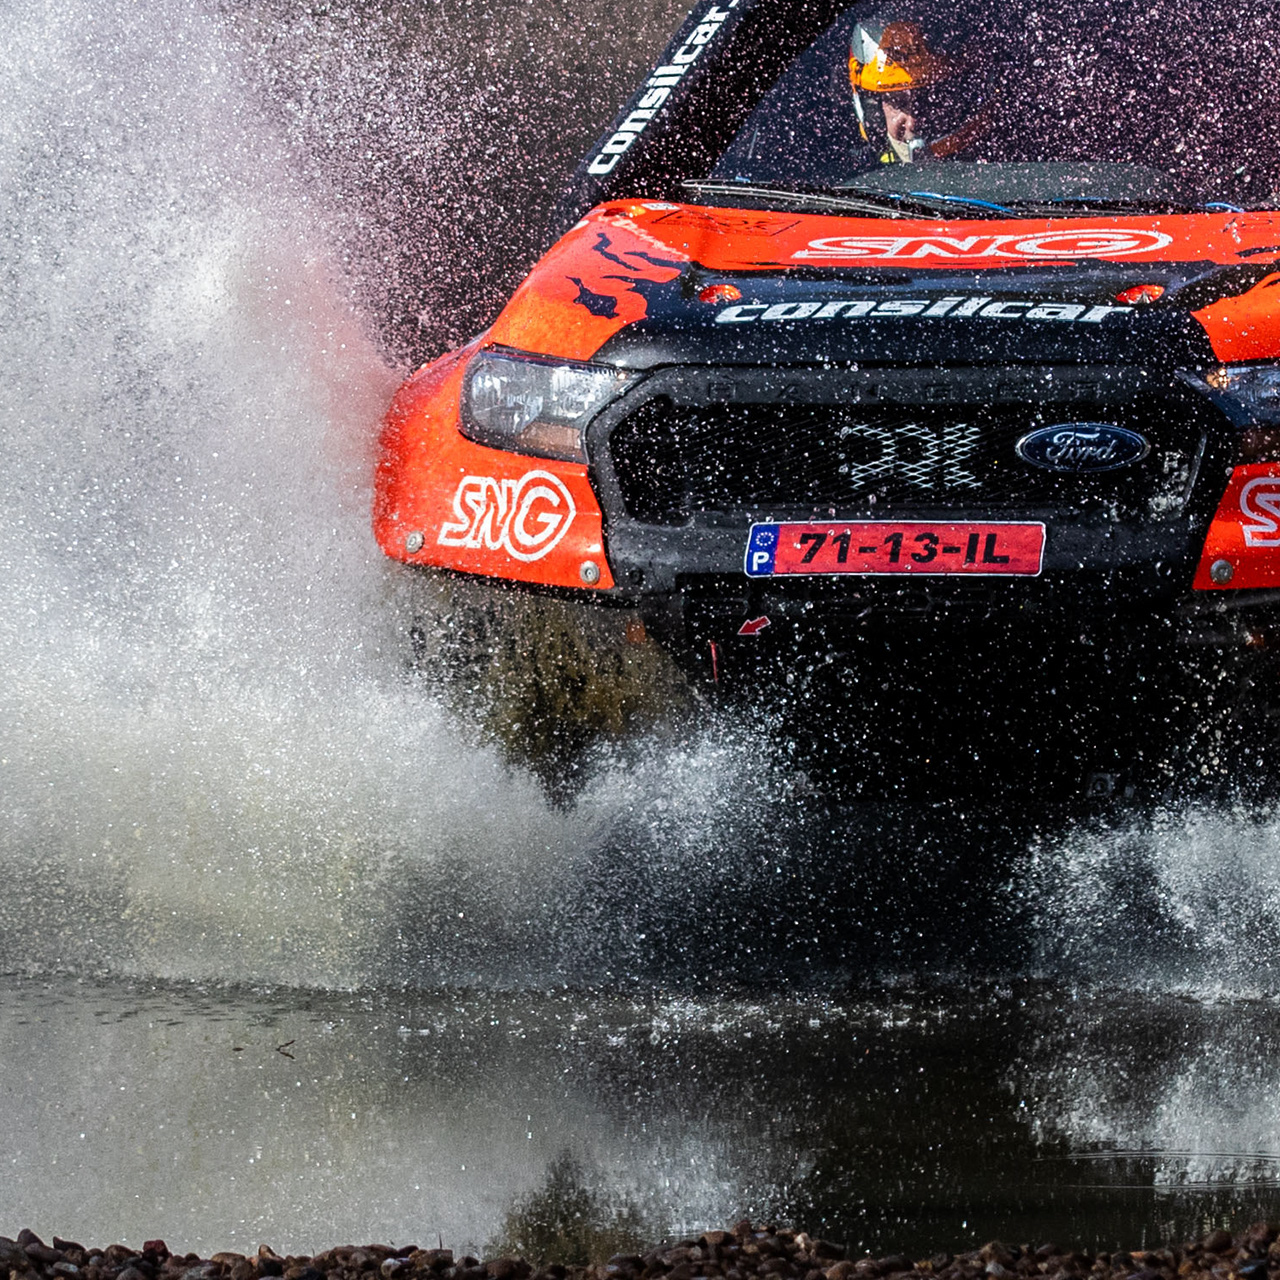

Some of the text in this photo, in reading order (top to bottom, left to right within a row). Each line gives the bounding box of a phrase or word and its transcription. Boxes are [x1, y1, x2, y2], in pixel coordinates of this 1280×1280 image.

[790, 228, 1174, 260] SNG
[715, 297, 1134, 323] consilcar
[1045, 431, 1118, 462] Ford
[436, 469, 577, 562] SNG
[752, 551, 770, 571] P
[798, 530, 1011, 565] 71-13-IL
